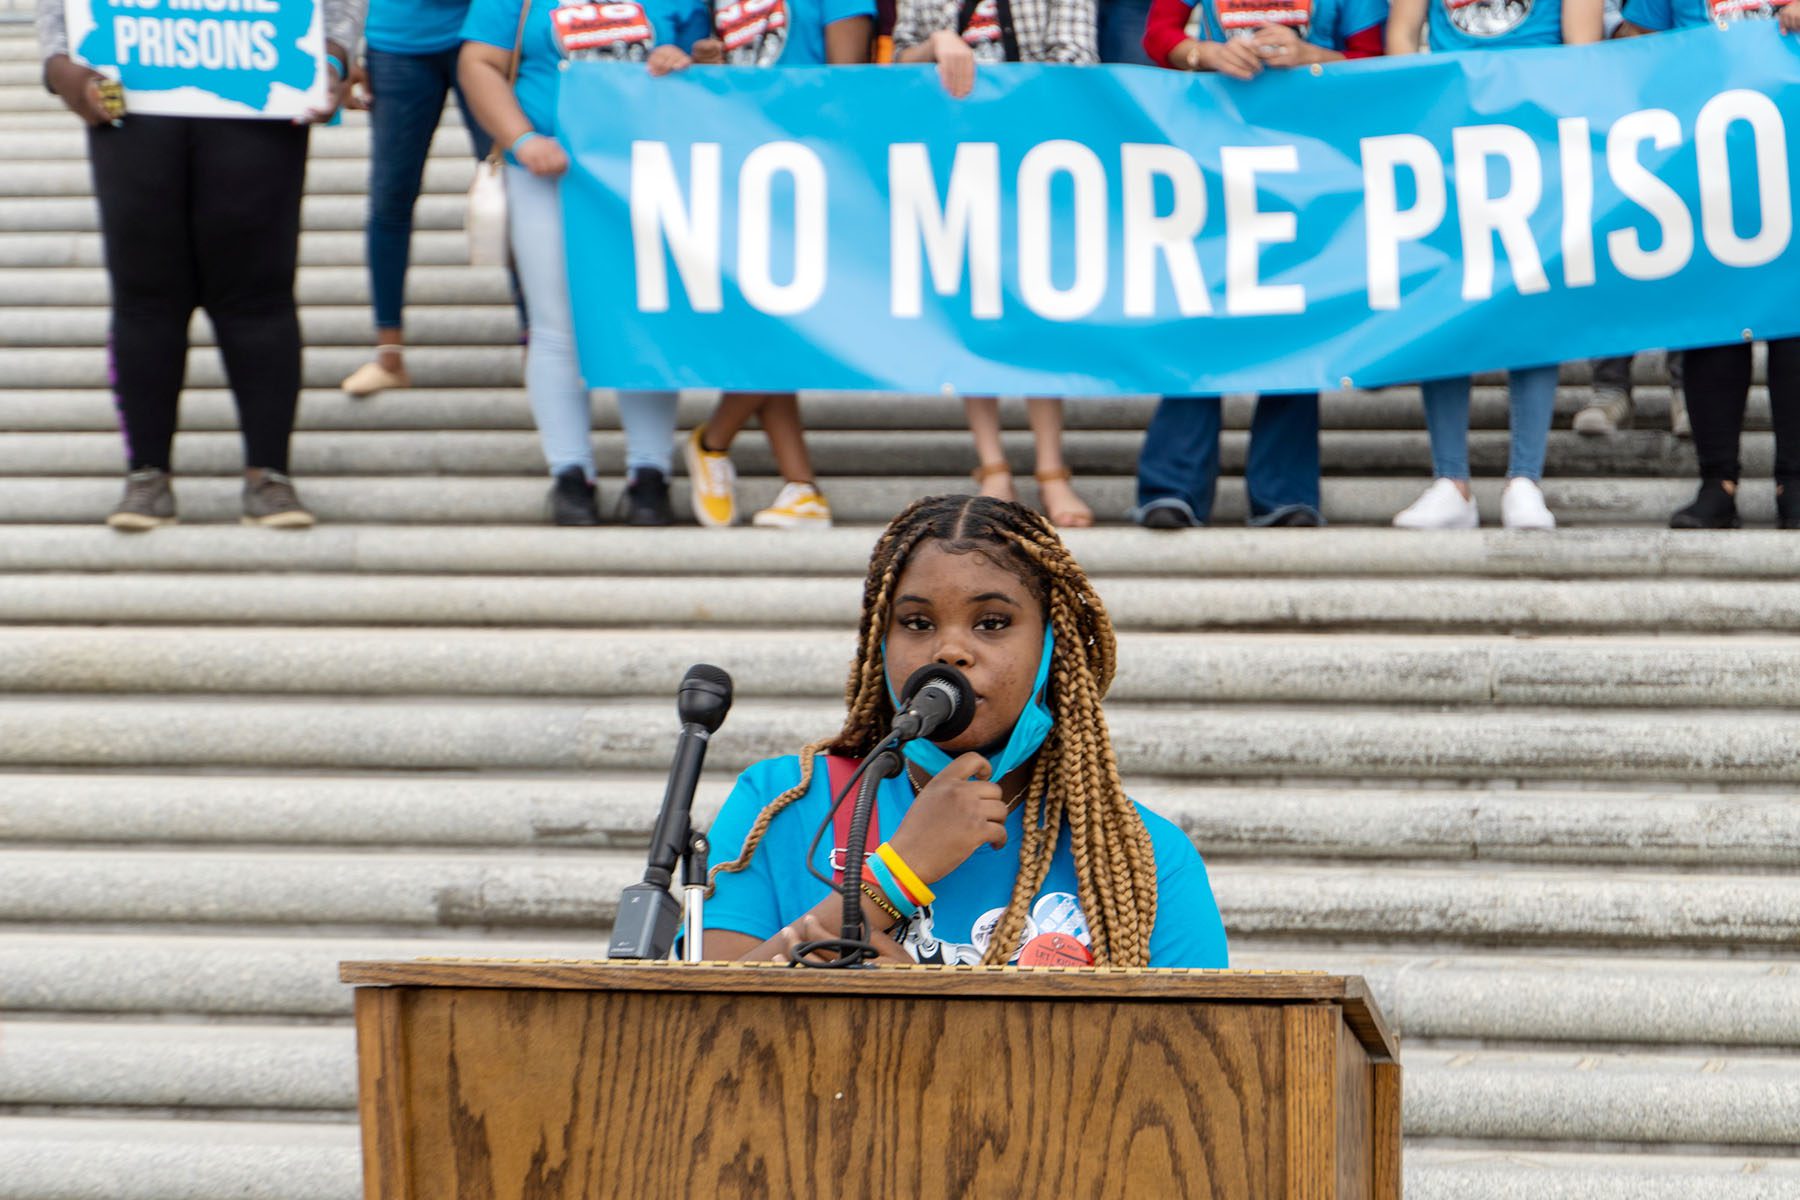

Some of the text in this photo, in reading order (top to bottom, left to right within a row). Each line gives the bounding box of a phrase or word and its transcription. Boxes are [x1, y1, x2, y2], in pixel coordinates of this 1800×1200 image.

[114, 15, 279, 71] PRISONS
[630, 88, 1792, 321] NO MORE PRISO
